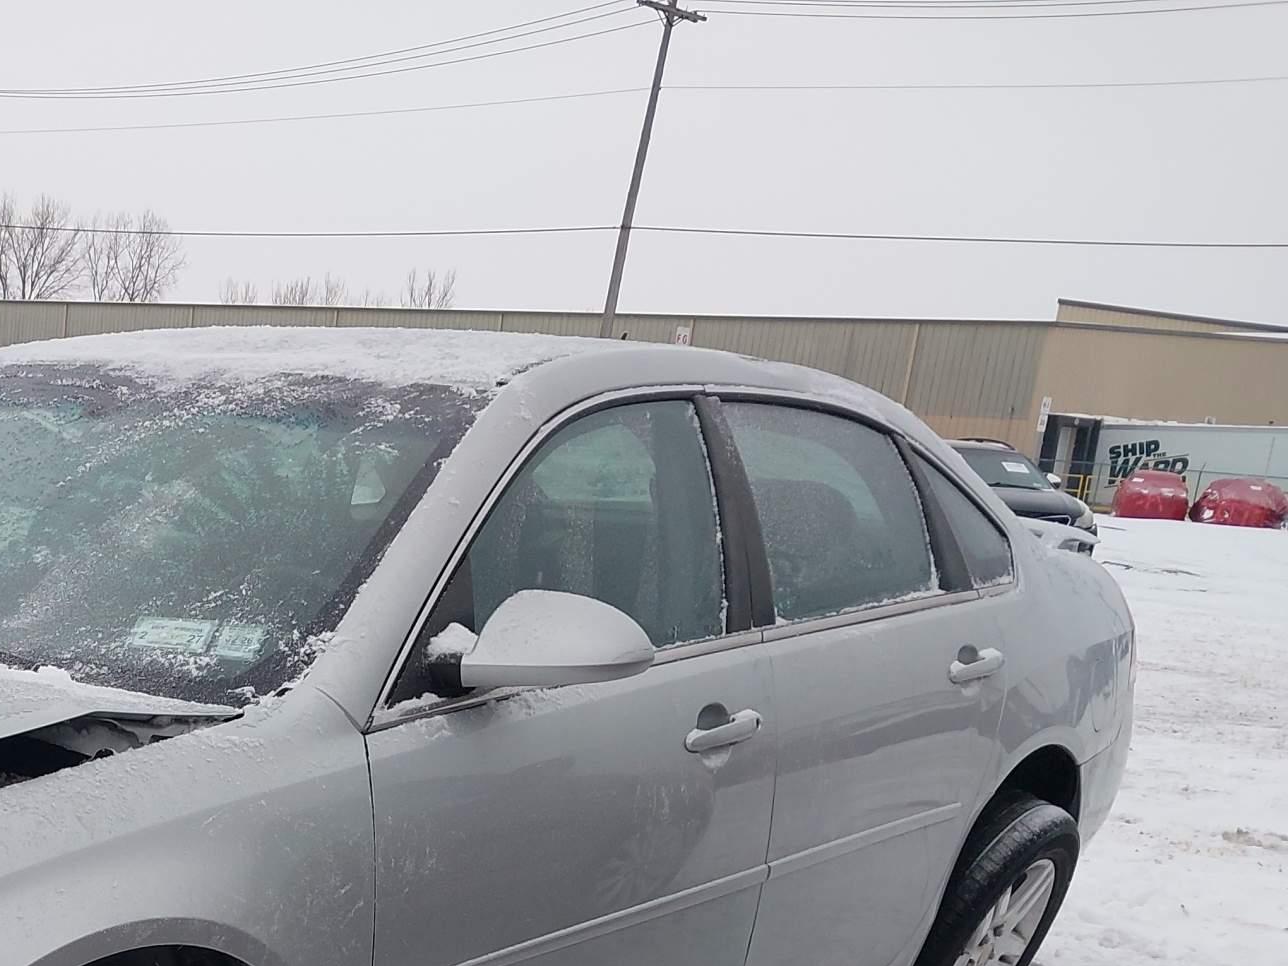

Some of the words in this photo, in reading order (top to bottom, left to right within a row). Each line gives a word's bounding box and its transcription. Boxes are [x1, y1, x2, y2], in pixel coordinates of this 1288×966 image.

[1108, 439, 1160, 460] SHIP
[1152, 451, 1167, 459] THE
[186, 634, 205, 644] 27
